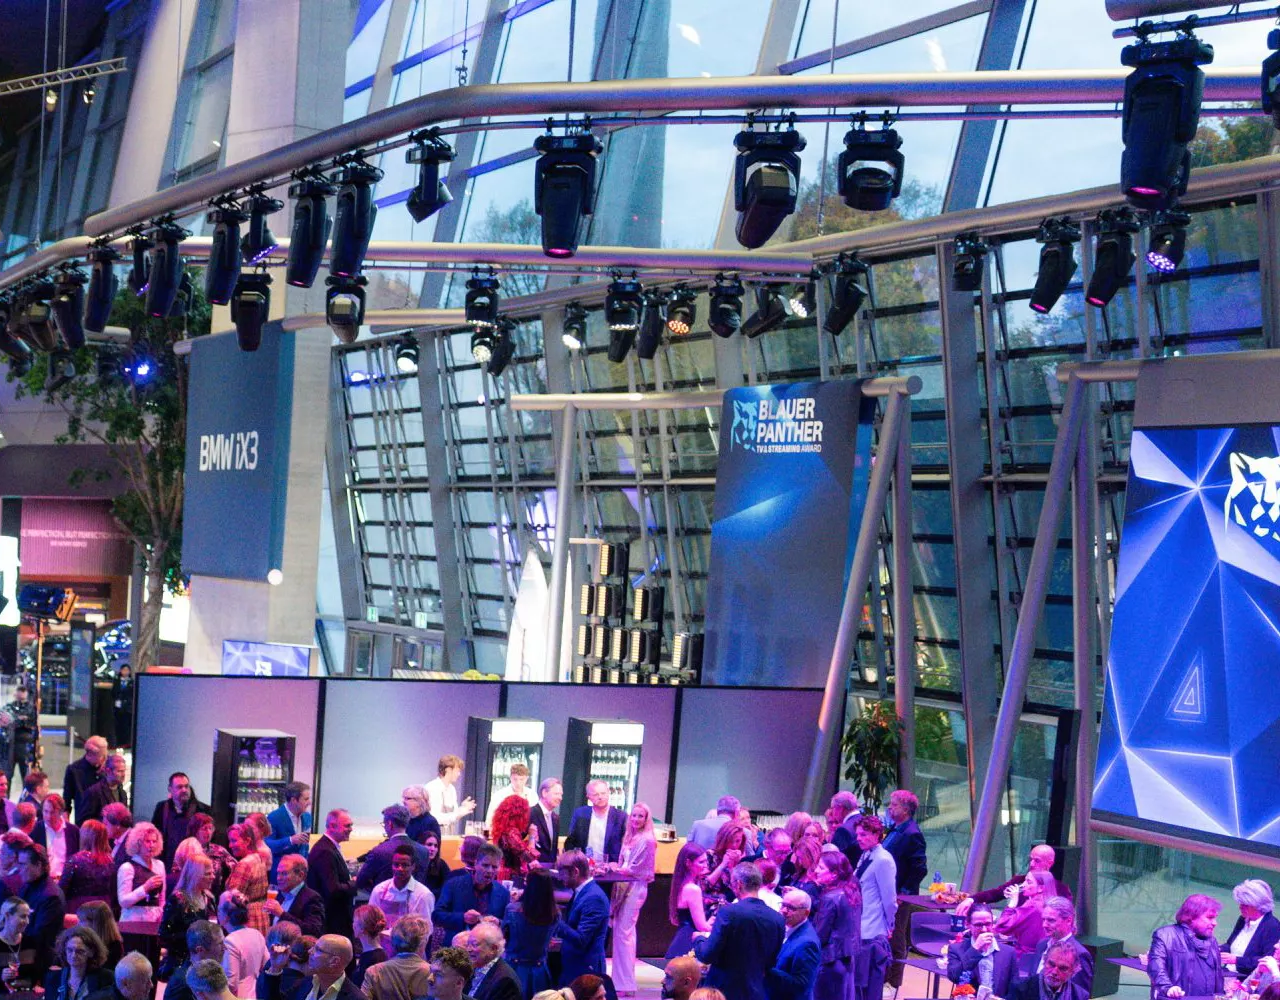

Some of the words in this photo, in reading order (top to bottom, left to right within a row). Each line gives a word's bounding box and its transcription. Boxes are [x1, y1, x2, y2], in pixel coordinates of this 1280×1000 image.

[758, 397, 816, 420] BLAUER
[756, 420, 824, 443] PANTHER
[199, 432, 234, 472] BMW
[235, 430, 259, 470] iX3
[768, 444, 801, 453] STREAMING
[801, 443, 822, 453] AWARD
